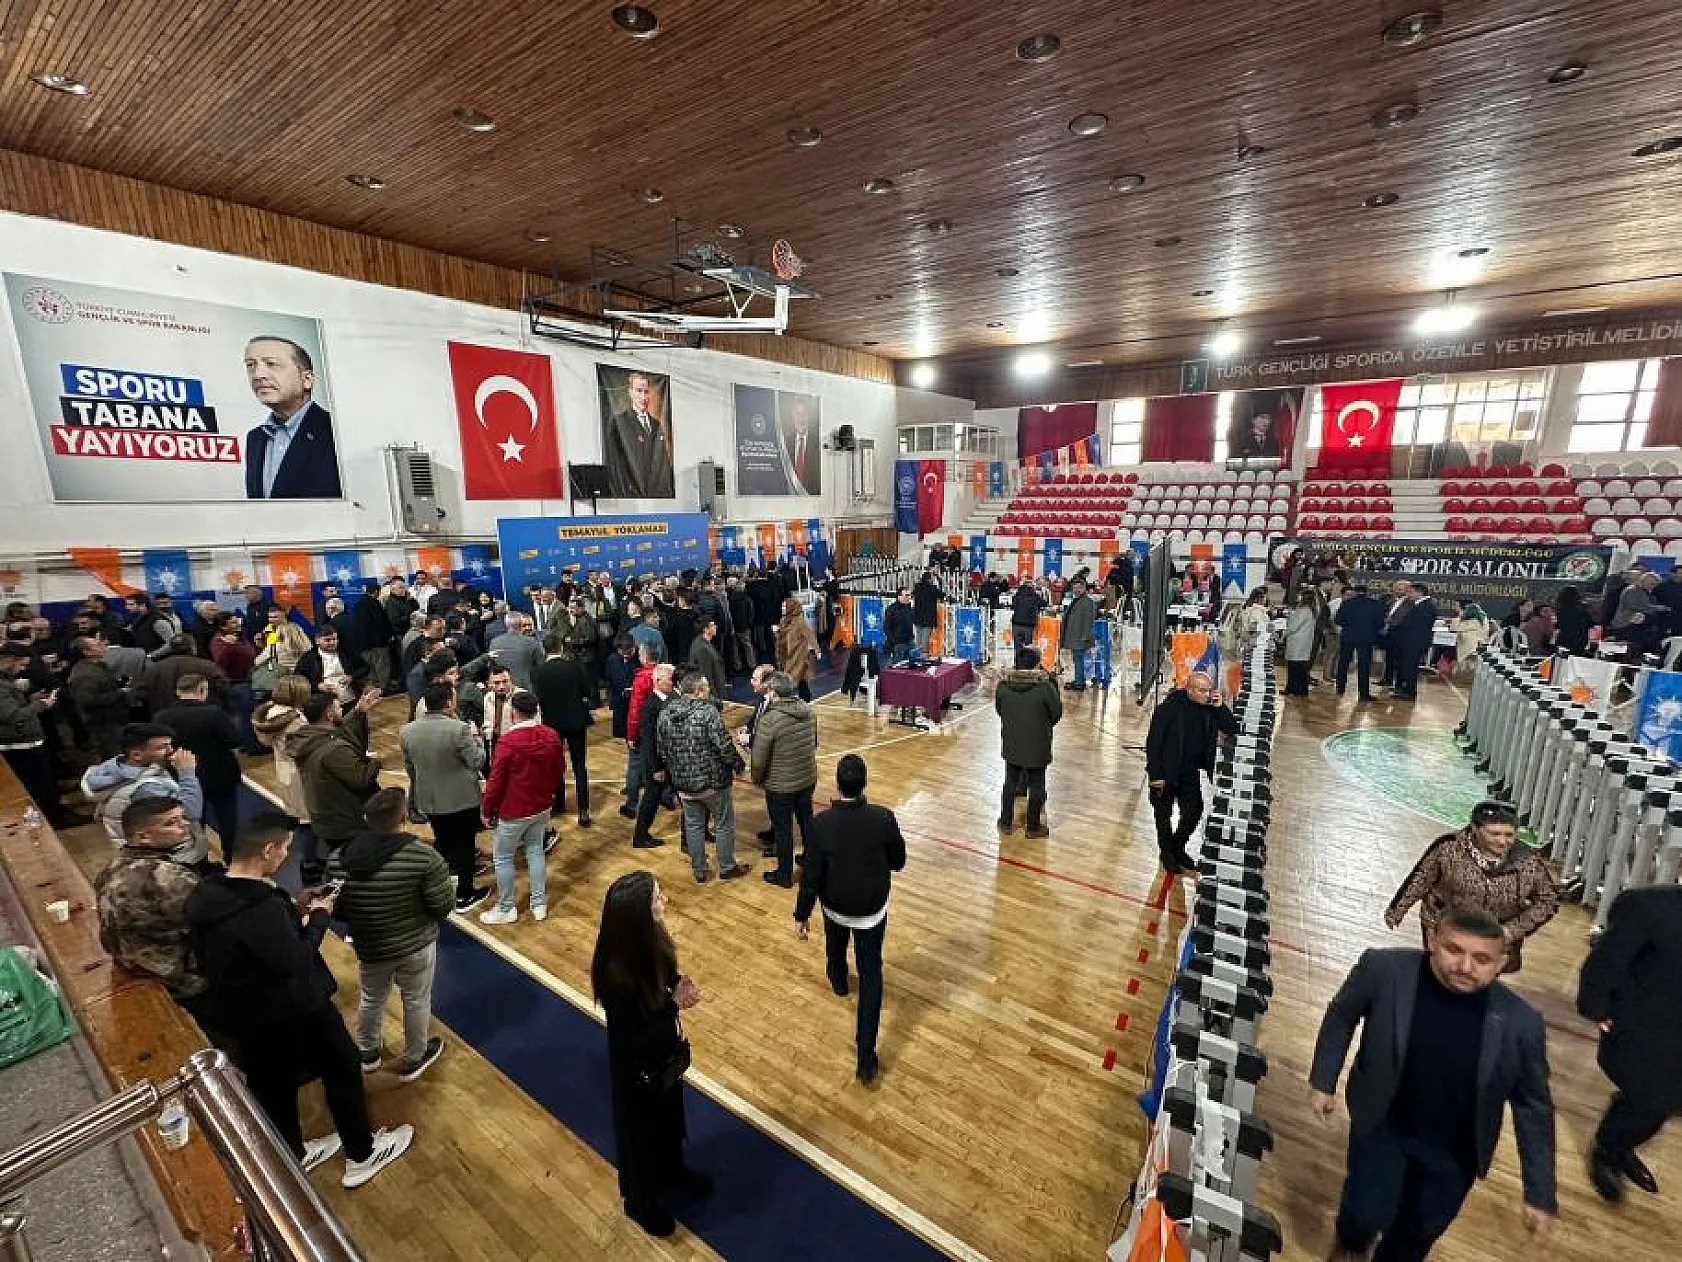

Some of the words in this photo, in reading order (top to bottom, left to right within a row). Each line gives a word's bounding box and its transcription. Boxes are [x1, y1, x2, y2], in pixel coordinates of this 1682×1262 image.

[1334, 351, 1404, 369] SPORDA
[76, 369, 186, 402] SPORU
[71, 402, 207, 431] TABANA
[57, 428, 236, 460] YAYIYORUZ
[1400, 556, 1453, 575] SPOR
[1457, 559, 1549, 579] SALONU
